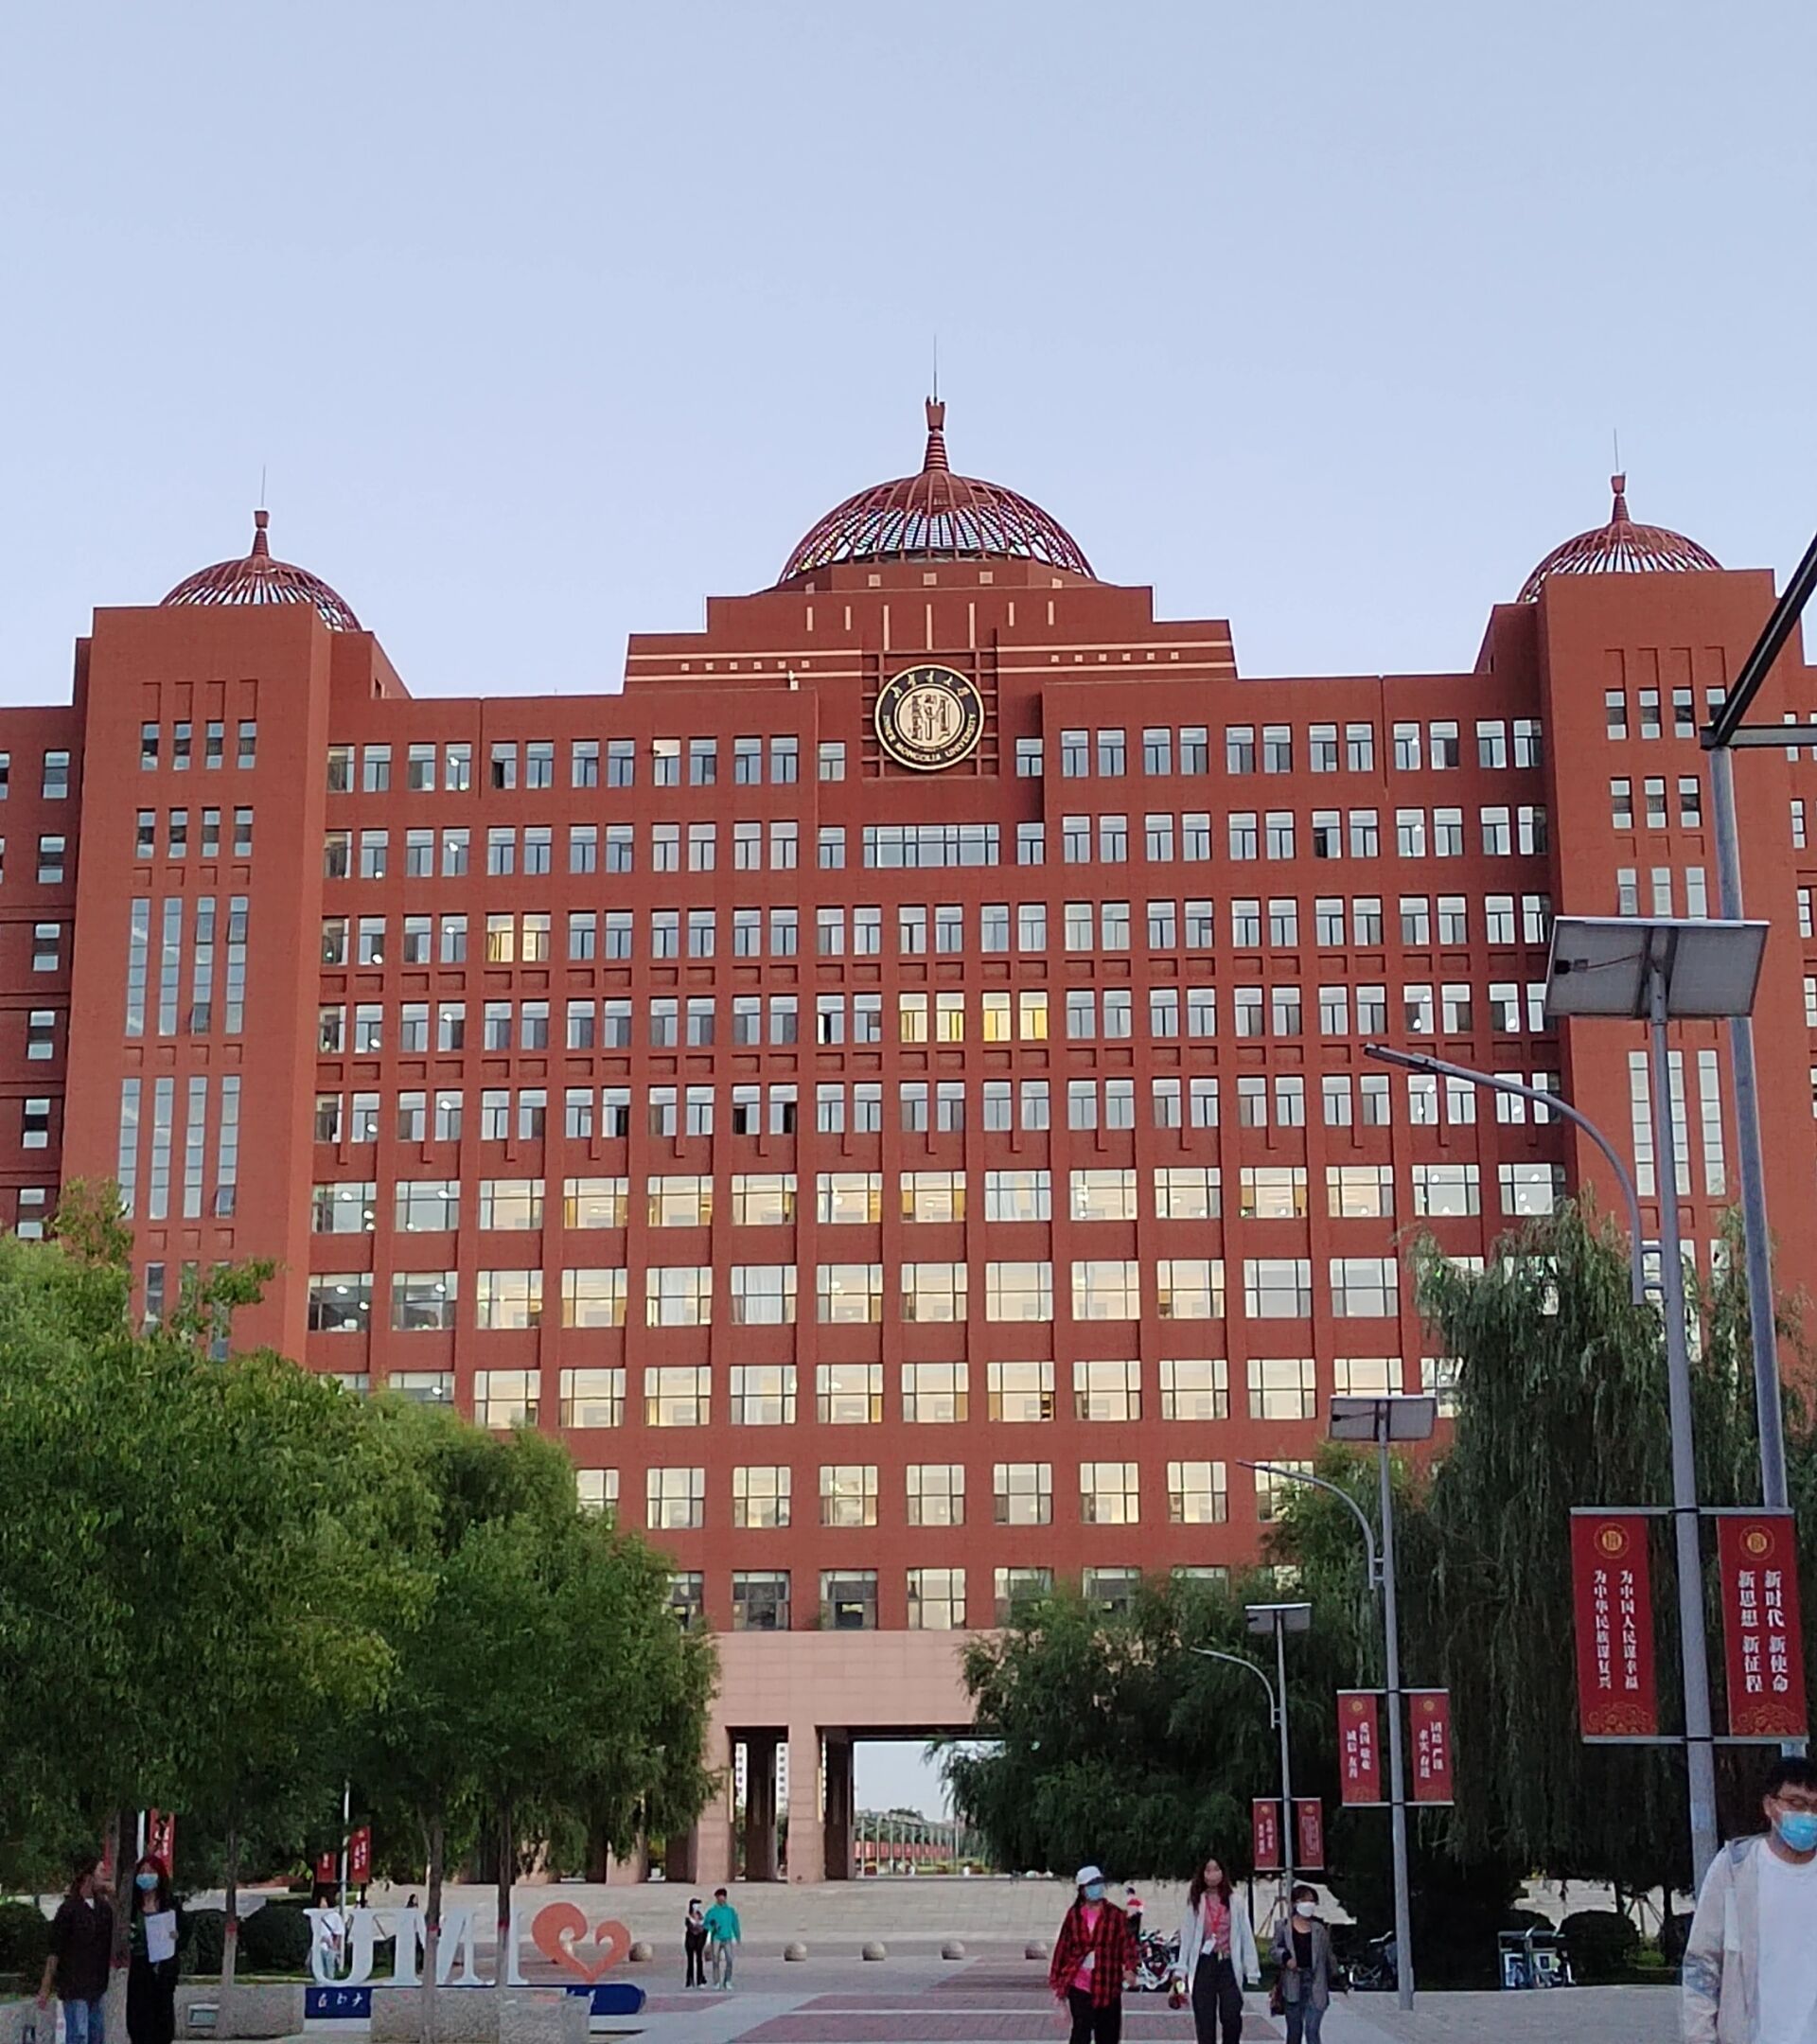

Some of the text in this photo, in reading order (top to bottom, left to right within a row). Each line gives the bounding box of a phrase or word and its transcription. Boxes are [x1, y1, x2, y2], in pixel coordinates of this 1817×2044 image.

[895, 742, 942, 762] MONGOLIA
[944, 714, 978, 757] UNIVERSITY
[1594, 1570, 1612, 1690] 为中华民族谋复兴
[1619, 1570, 1639, 1690] 为中国人民谋幸福
